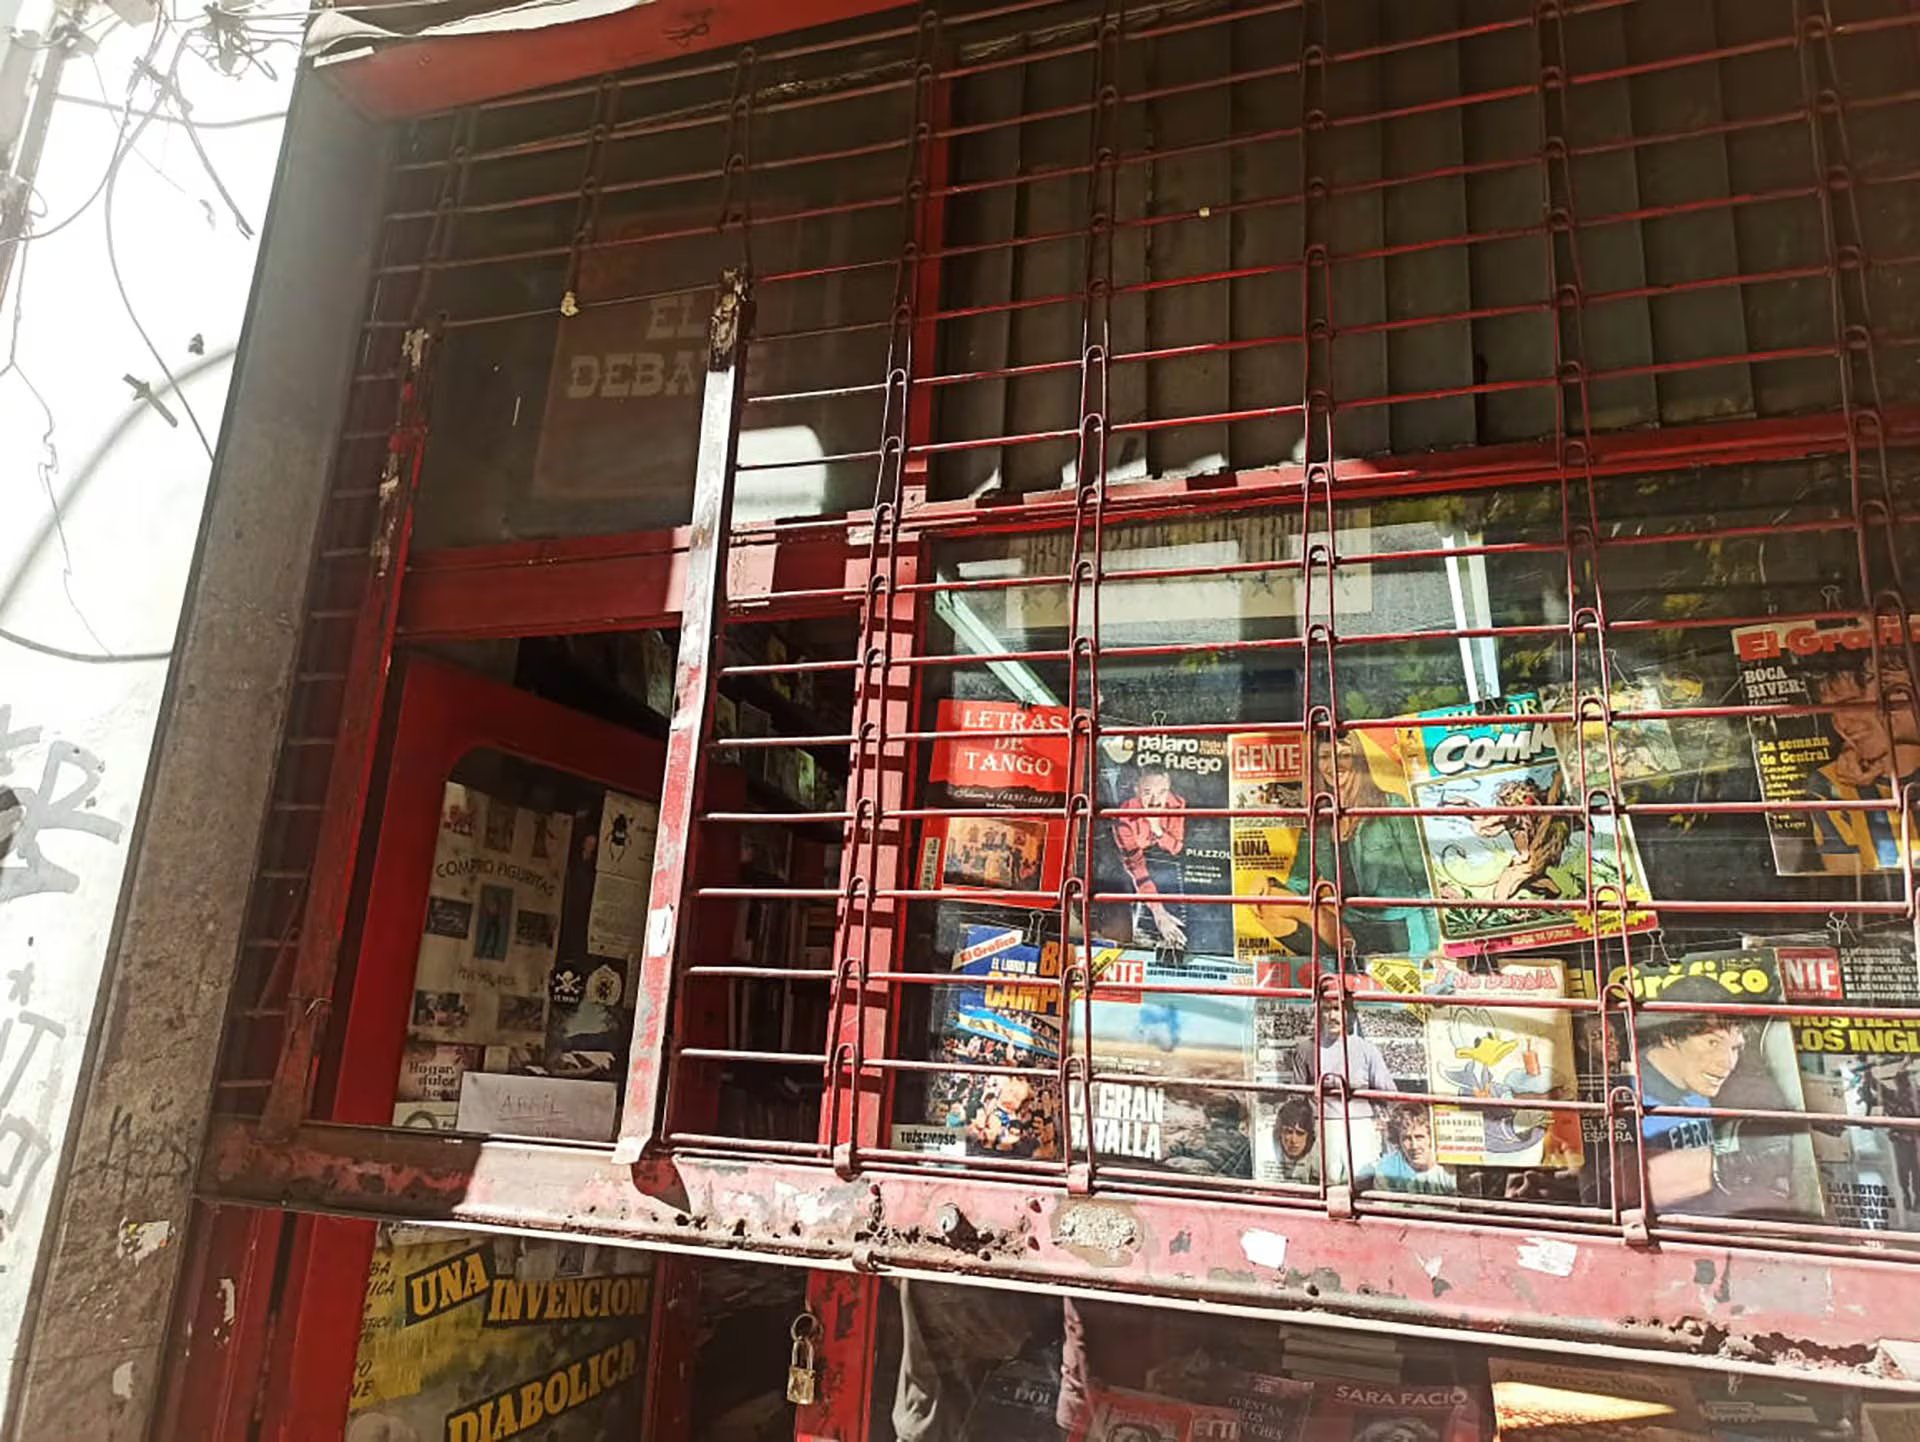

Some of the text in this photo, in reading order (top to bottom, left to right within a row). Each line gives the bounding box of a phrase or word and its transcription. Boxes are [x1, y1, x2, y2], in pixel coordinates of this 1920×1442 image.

[568, 350, 768, 399] DEBAE
[1744, 666, 1788, 684] BOCA
[963, 709, 1064, 732] LETRAS
[964, 751, 1053, 776] TANGO
[1137, 752, 1222, 775] de fuego
[1235, 743, 1301, 771] GENTE
[1780, 747, 1831, 763] Central
[1234, 840, 1270, 856] LUNA
[1099, 1082, 1165, 1123] GRAN
[1584, 1131, 1634, 1143] ESPRA
[411, 1252, 489, 1325] UNA
[488, 1277, 649, 1321] INVENCION
[449, 1339, 637, 1442] DIABOLICA
[1335, 1385, 1469, 1406] SARA FACIO
